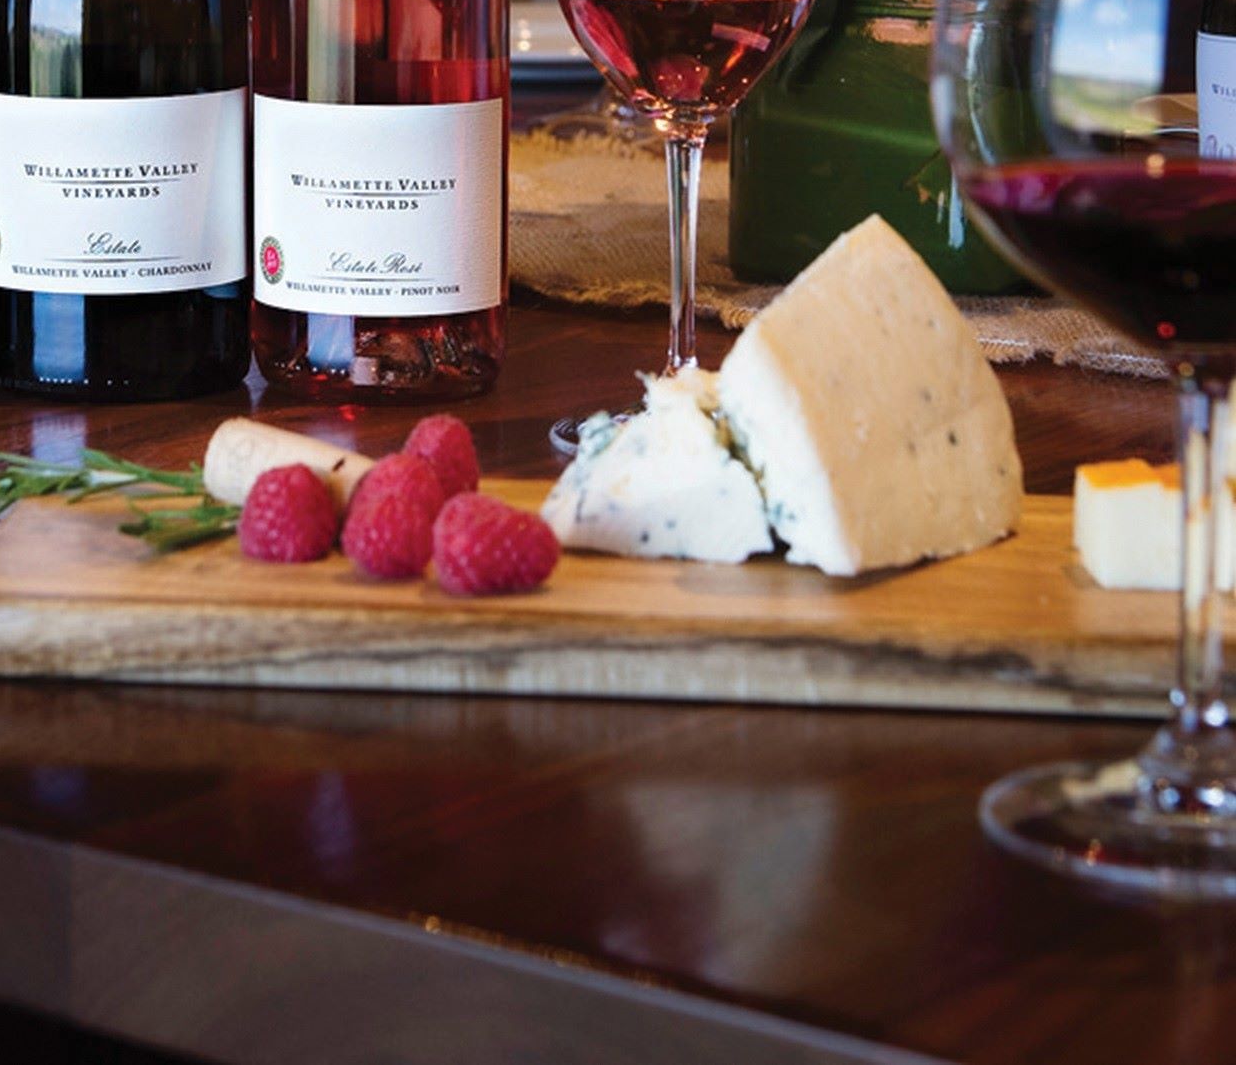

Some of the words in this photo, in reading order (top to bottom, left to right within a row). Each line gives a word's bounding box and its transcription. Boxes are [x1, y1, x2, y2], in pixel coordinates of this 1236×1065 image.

[24, 164, 134, 178] WILLAMETTE
[139, 163, 199, 177] VALLEY
[291, 174, 393, 190] WILLAMETTE
[398, 178, 457, 191] VALLEY
[62, 186, 161, 198] VINEYARDS
[325, 198, 419, 210] VINEYARDS
[83, 232, 142, 255] Estate
[12, 264, 79, 278] WILLAMETTE
[83, 268, 128, 278] VALLEY
[139, 261, 212, 277] CHARDONNAY
[325, 251, 377, 273] Estate
[286, 281, 346, 295] WILLAMETTE
[350, 287, 391, 296] VALLEY
[401, 286, 433, 296] PINOT
[436, 284, 460, 294] NOIR
